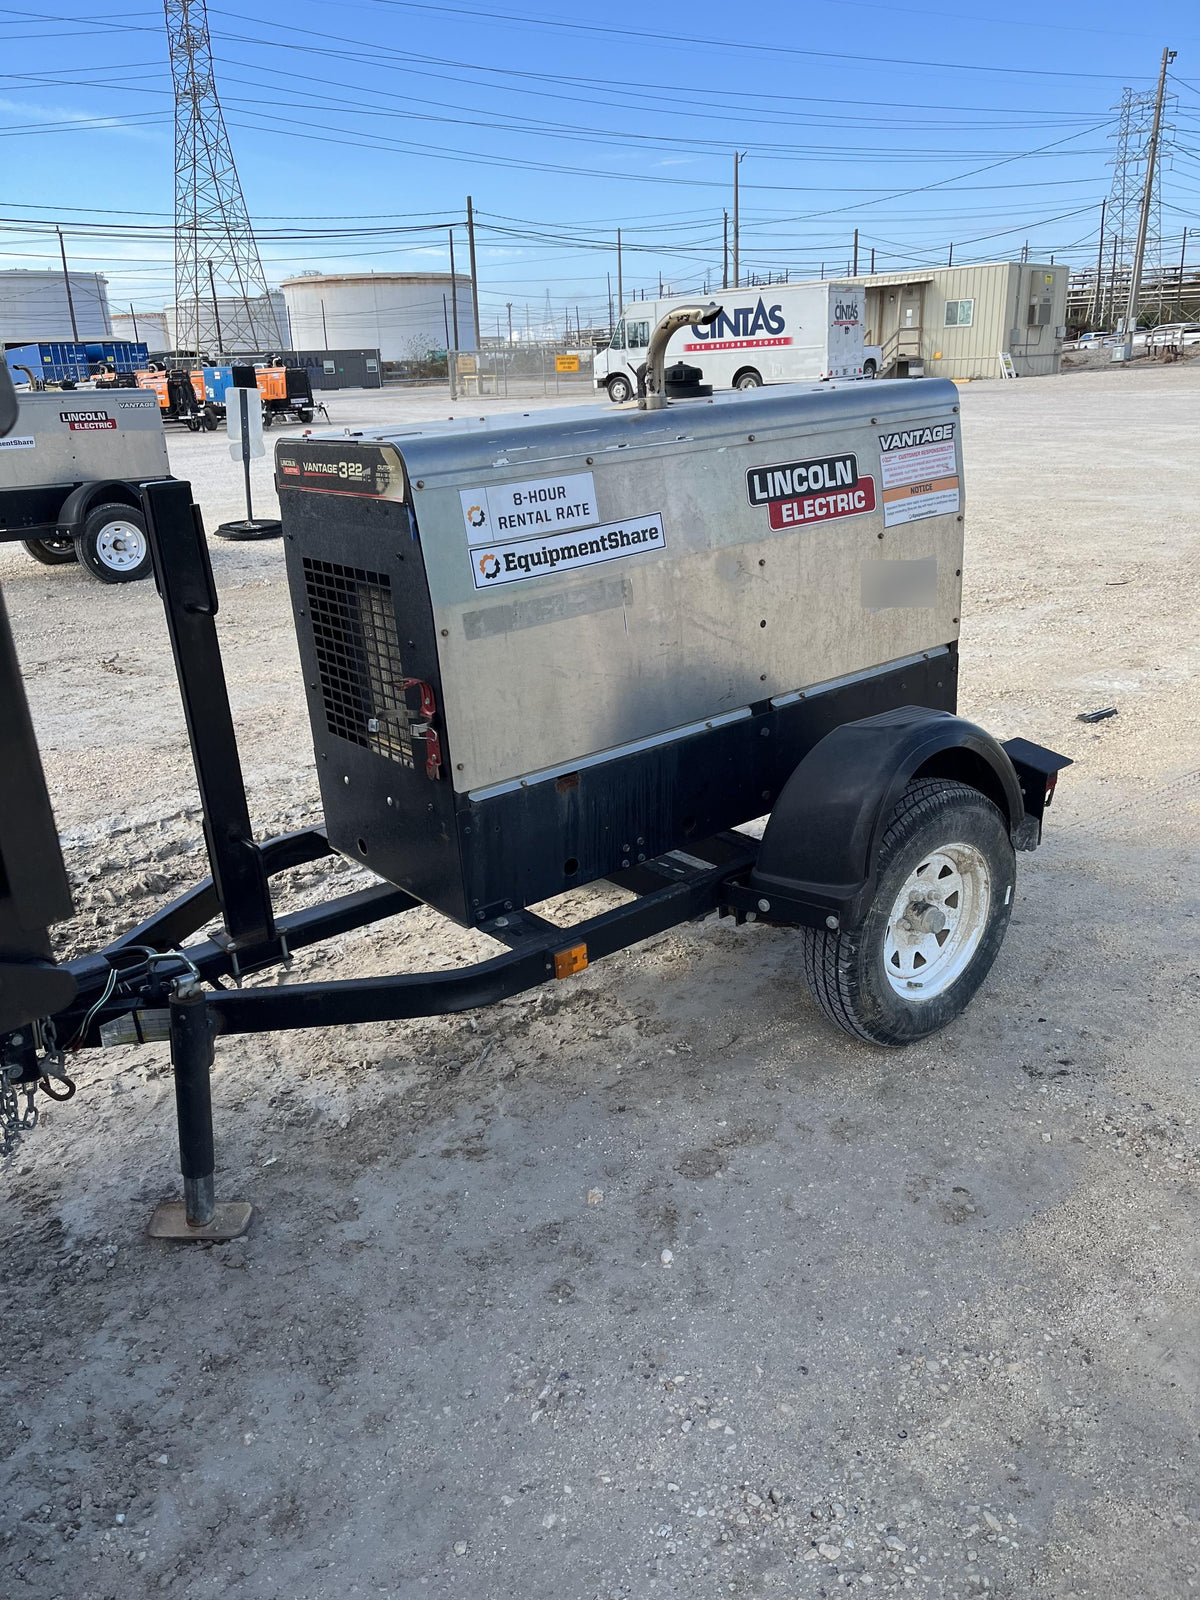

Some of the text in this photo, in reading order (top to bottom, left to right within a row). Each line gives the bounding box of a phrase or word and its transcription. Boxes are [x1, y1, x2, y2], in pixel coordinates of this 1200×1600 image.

[692, 296, 786, 340] CINTAS
[834, 300, 858, 320] CINTAS
[710, 341, 747, 349] UNIFORM
[62, 412, 106, 422] LINCOLN
[74, 422, 113, 430] ELECTRIC
[879, 423, 954, 451] VANTAGE
[898, 451, 921, 460] CUSTOMER
[921, 445, 954, 456] RESPONSIBILITY
[281, 459, 296, 467] LINCOLN
[303, 462, 338, 474] VANTAGE
[338, 461, 363, 478] 322
[753, 460, 853, 500] LINCOLN
[910, 483, 933, 494] NOTICE
[513, 486, 567, 505] 8-HOUR
[498, 502, 591, 530] RENTAL RATE
[781, 490, 866, 523] ELECTRIC
[503, 526, 659, 573] EquipmentShare
